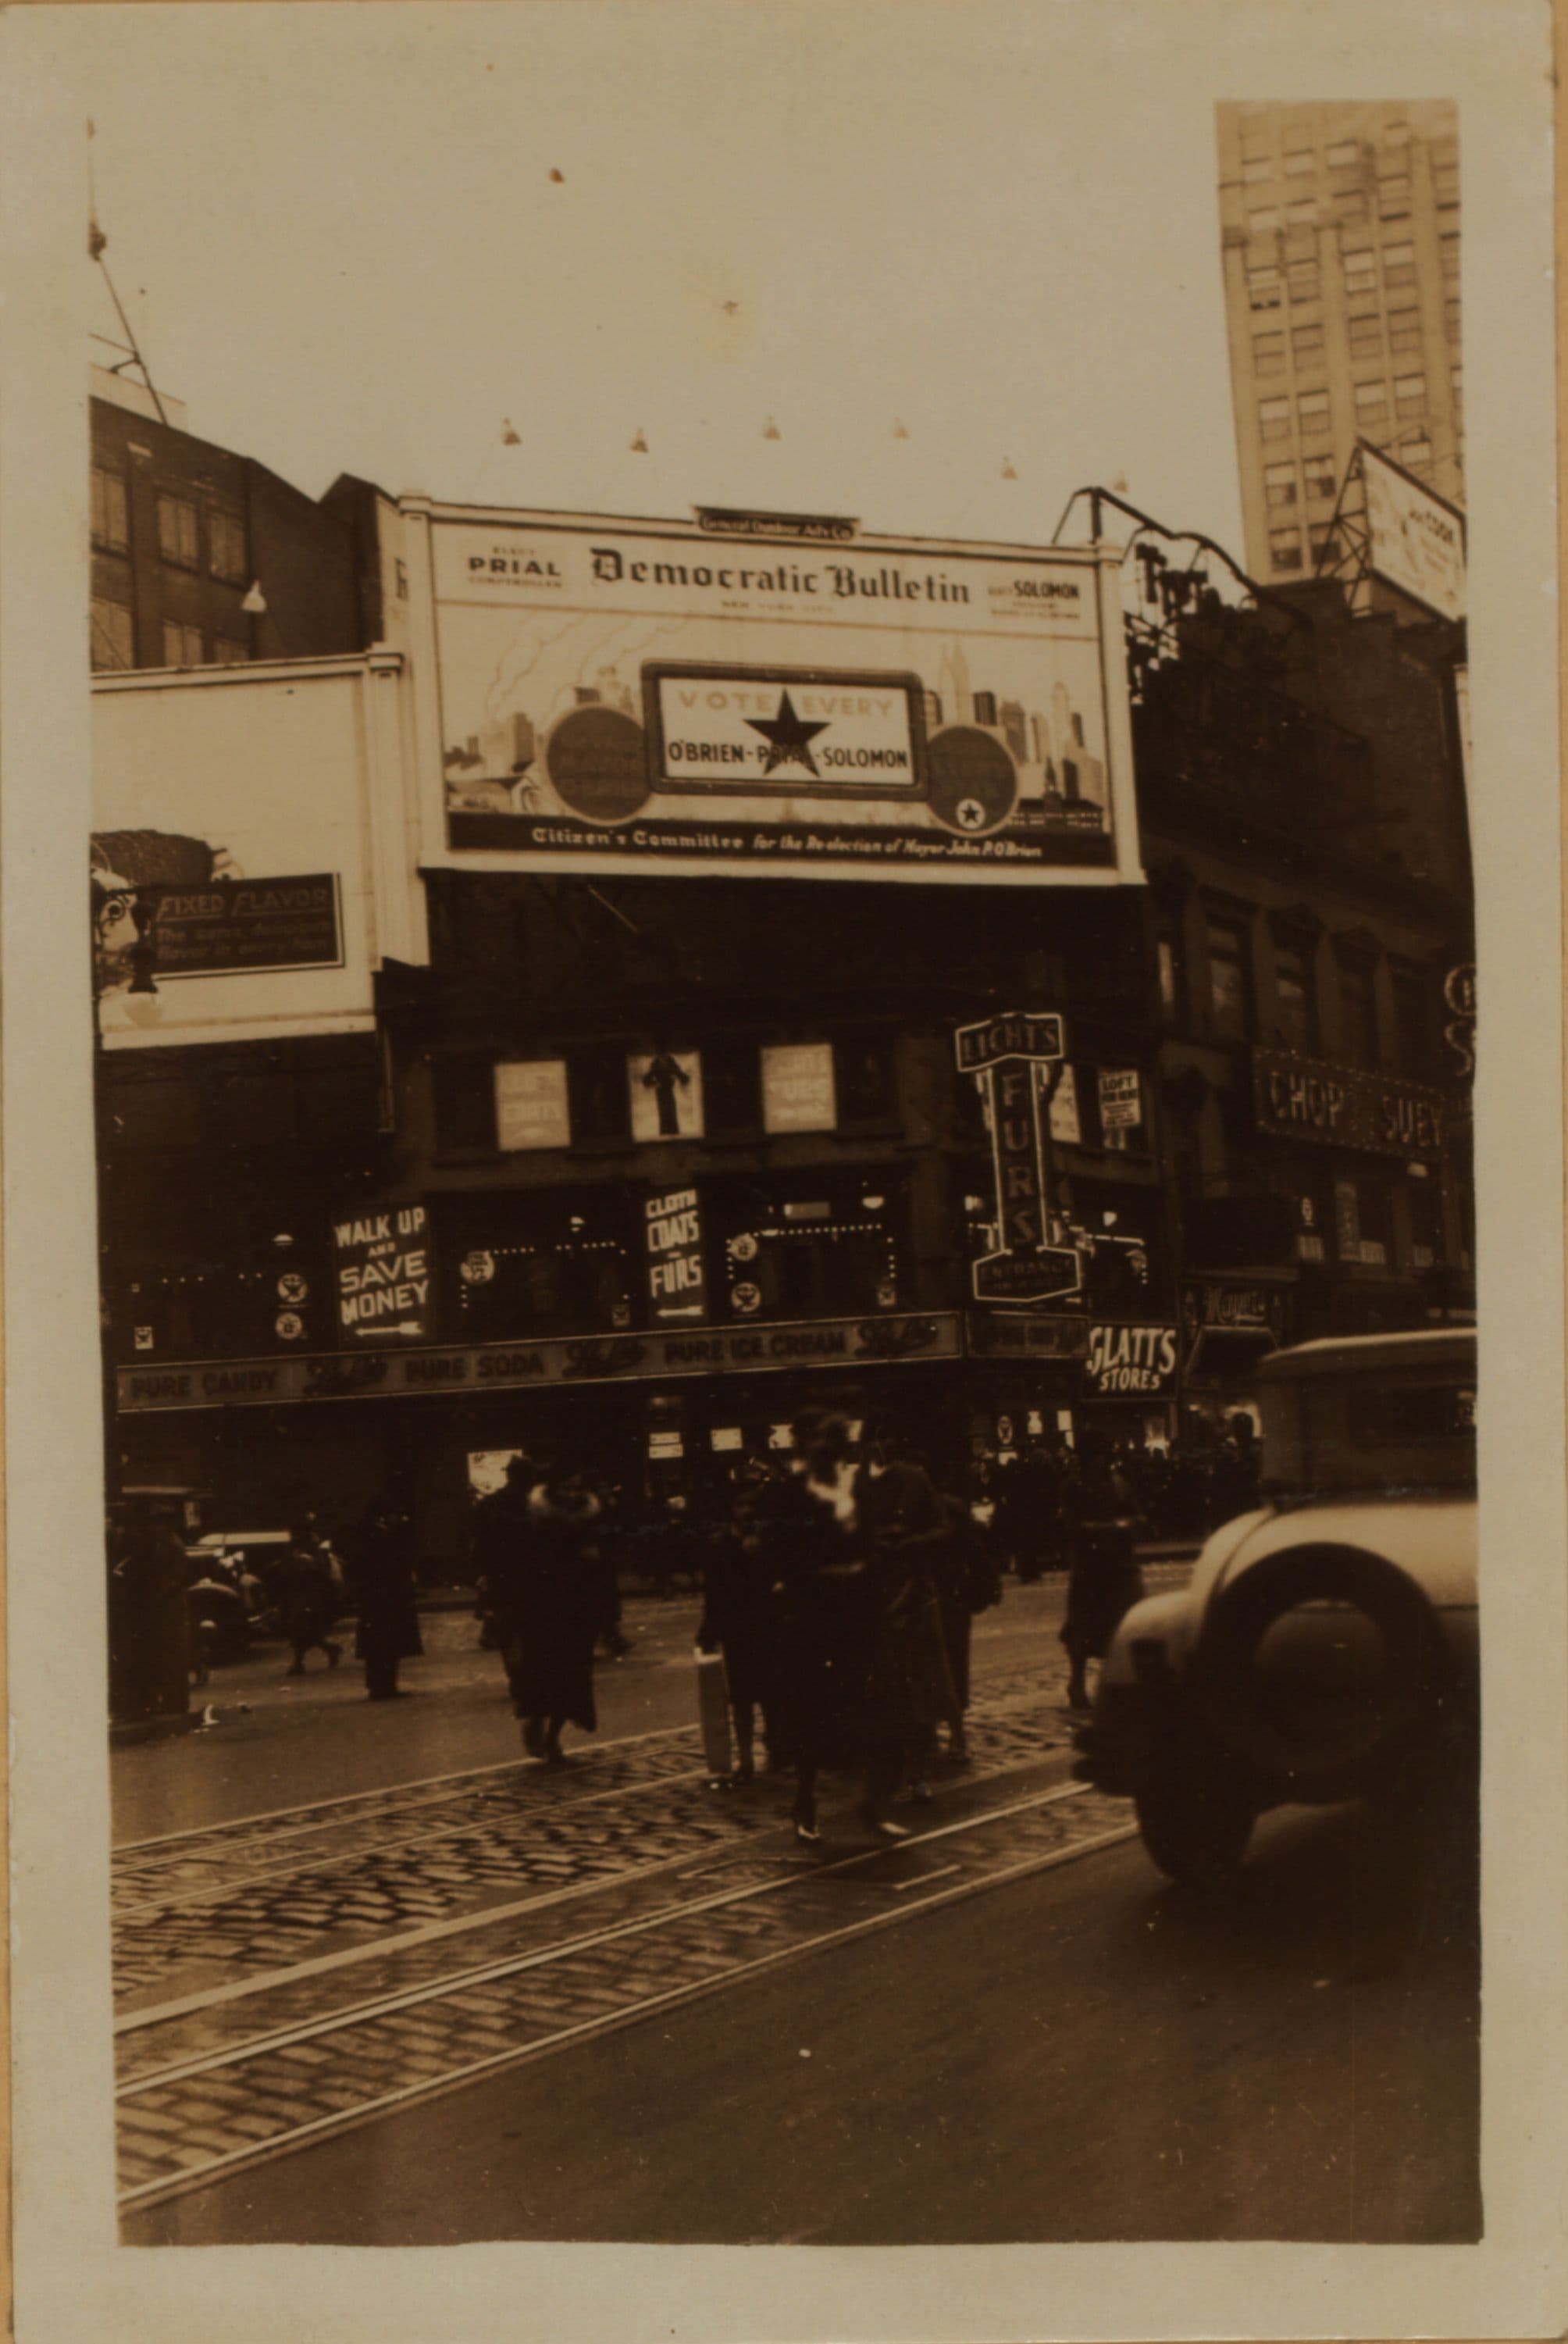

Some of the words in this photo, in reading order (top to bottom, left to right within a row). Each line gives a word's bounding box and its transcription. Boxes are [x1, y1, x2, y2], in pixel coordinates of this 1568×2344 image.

[468, 556, 561, 577] PRIAL
[590, 547, 816, 594] Democratic
[825, 565, 968, 604] Bulletin
[1014, 579, 1079, 601] SOLOMON
[676, 691, 772, 712] VOTE
[801, 695, 892, 716] EVERY
[631, 831, 745, 849] Committee
[752, 833, 778, 851] for
[884, 839, 903, 853] of
[230, 887, 330, 917] FLAVOR
[996, 1071, 1037, 1247] FURS
[646, 1189, 698, 1219] CLOTH
[336, 1220, 390, 1248] WALK
[398, 1208, 426, 1234] UP
[647, 1209, 701, 1252] COATS
[340, 1250, 428, 1293] SAVE
[650, 1254, 704, 1299] FURS
[340, 1280, 430, 1326] MONEY
[664, 1336, 722, 1365] PURE
[770, 1328, 845, 1357] CREAM
[406, 1356, 467, 1382] PURE
[478, 1350, 543, 1379] SODA
[131, 1375, 191, 1399] PURE
[201, 1368, 275, 1395] CANDY
